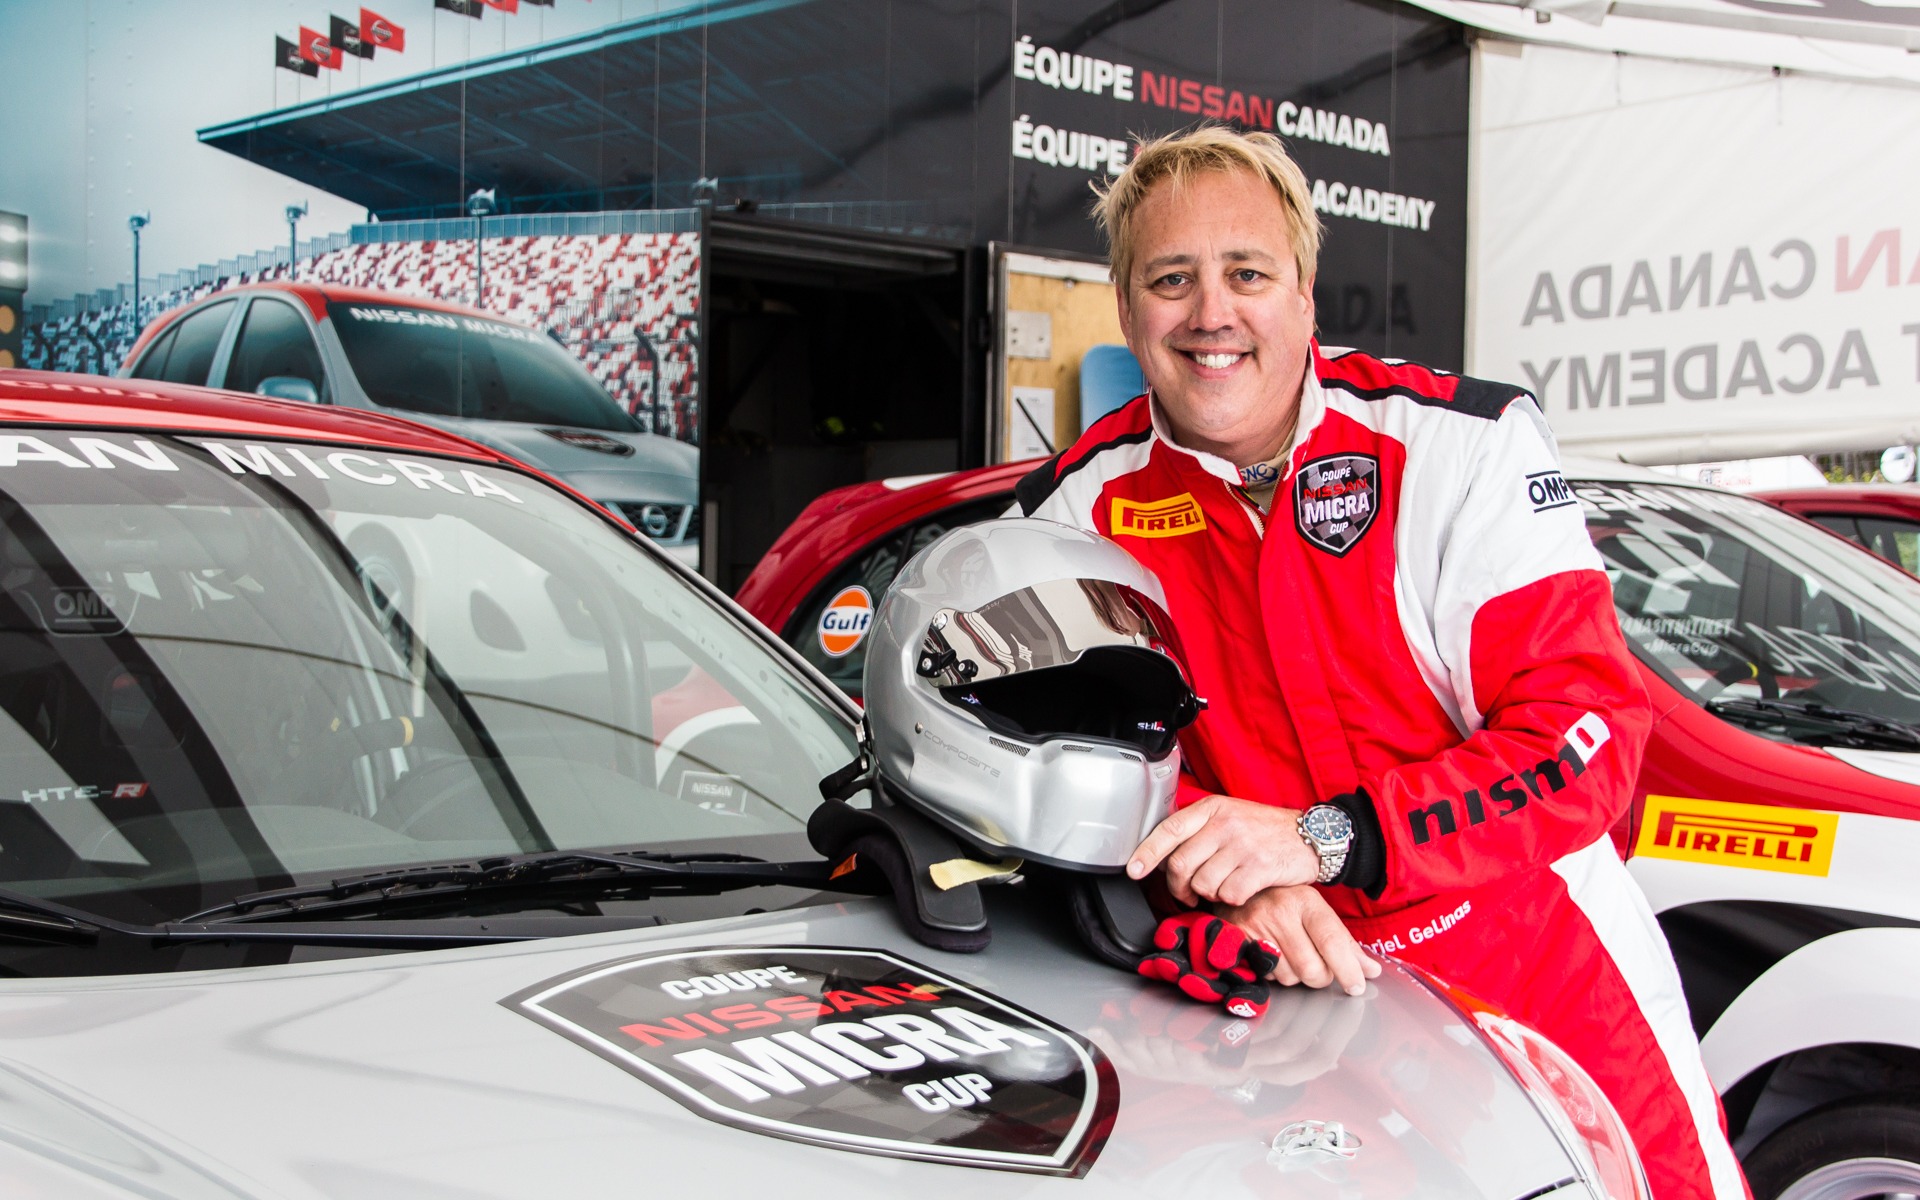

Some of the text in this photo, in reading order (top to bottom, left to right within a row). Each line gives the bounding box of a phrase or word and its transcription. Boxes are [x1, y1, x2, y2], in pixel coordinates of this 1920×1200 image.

[1014, 35, 1391, 157] ÉQUIPE NISSAN CANADA
[1012, 114, 1128, 176] ÉQUIPE
[1311, 179, 1435, 232] ACADEMY
[350, 307, 544, 344] NISSAN MICRA
[201, 441, 525, 505] MICRA
[1303, 477, 1368, 499] NISSAN
[1321, 466, 1352, 482] COUPE
[1528, 476, 1569, 505] OMP
[1304, 491, 1370, 524] MICRA
[1329, 521, 1349, 534] CUP
[823, 611, 871, 631] Gulf
[924, 730, 1001, 778] COMPOSITE
[691, 782, 733, 797] NISSAN
[1654, 810, 1819, 863] PIRELLI
[659, 965, 809, 1001] COUPE
[618, 982, 945, 1049] NISSAN
[672, 1006, 1051, 1103] MICRA
[903, 1072, 994, 1115] CUP
